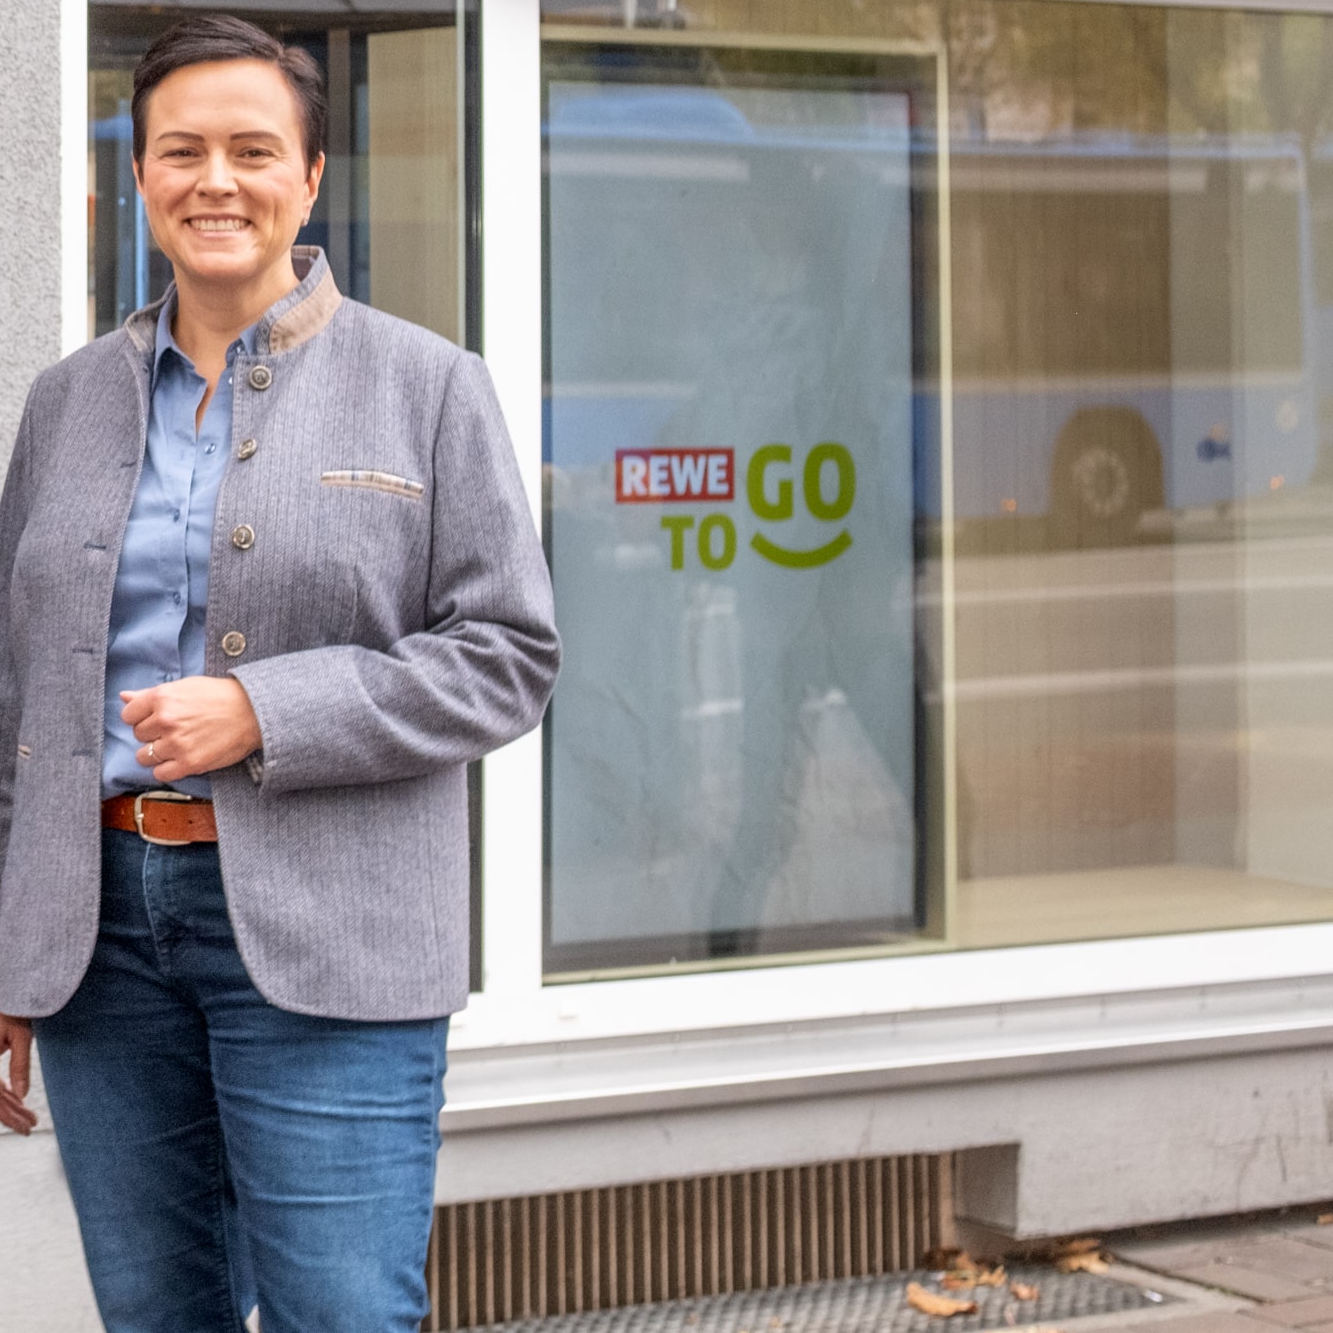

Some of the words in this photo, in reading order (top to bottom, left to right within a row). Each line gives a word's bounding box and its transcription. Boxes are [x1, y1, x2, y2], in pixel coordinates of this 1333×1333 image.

[621, 453, 730, 497] REWE
[659, 512, 737, 572] TO
[746, 441, 857, 523] GO
